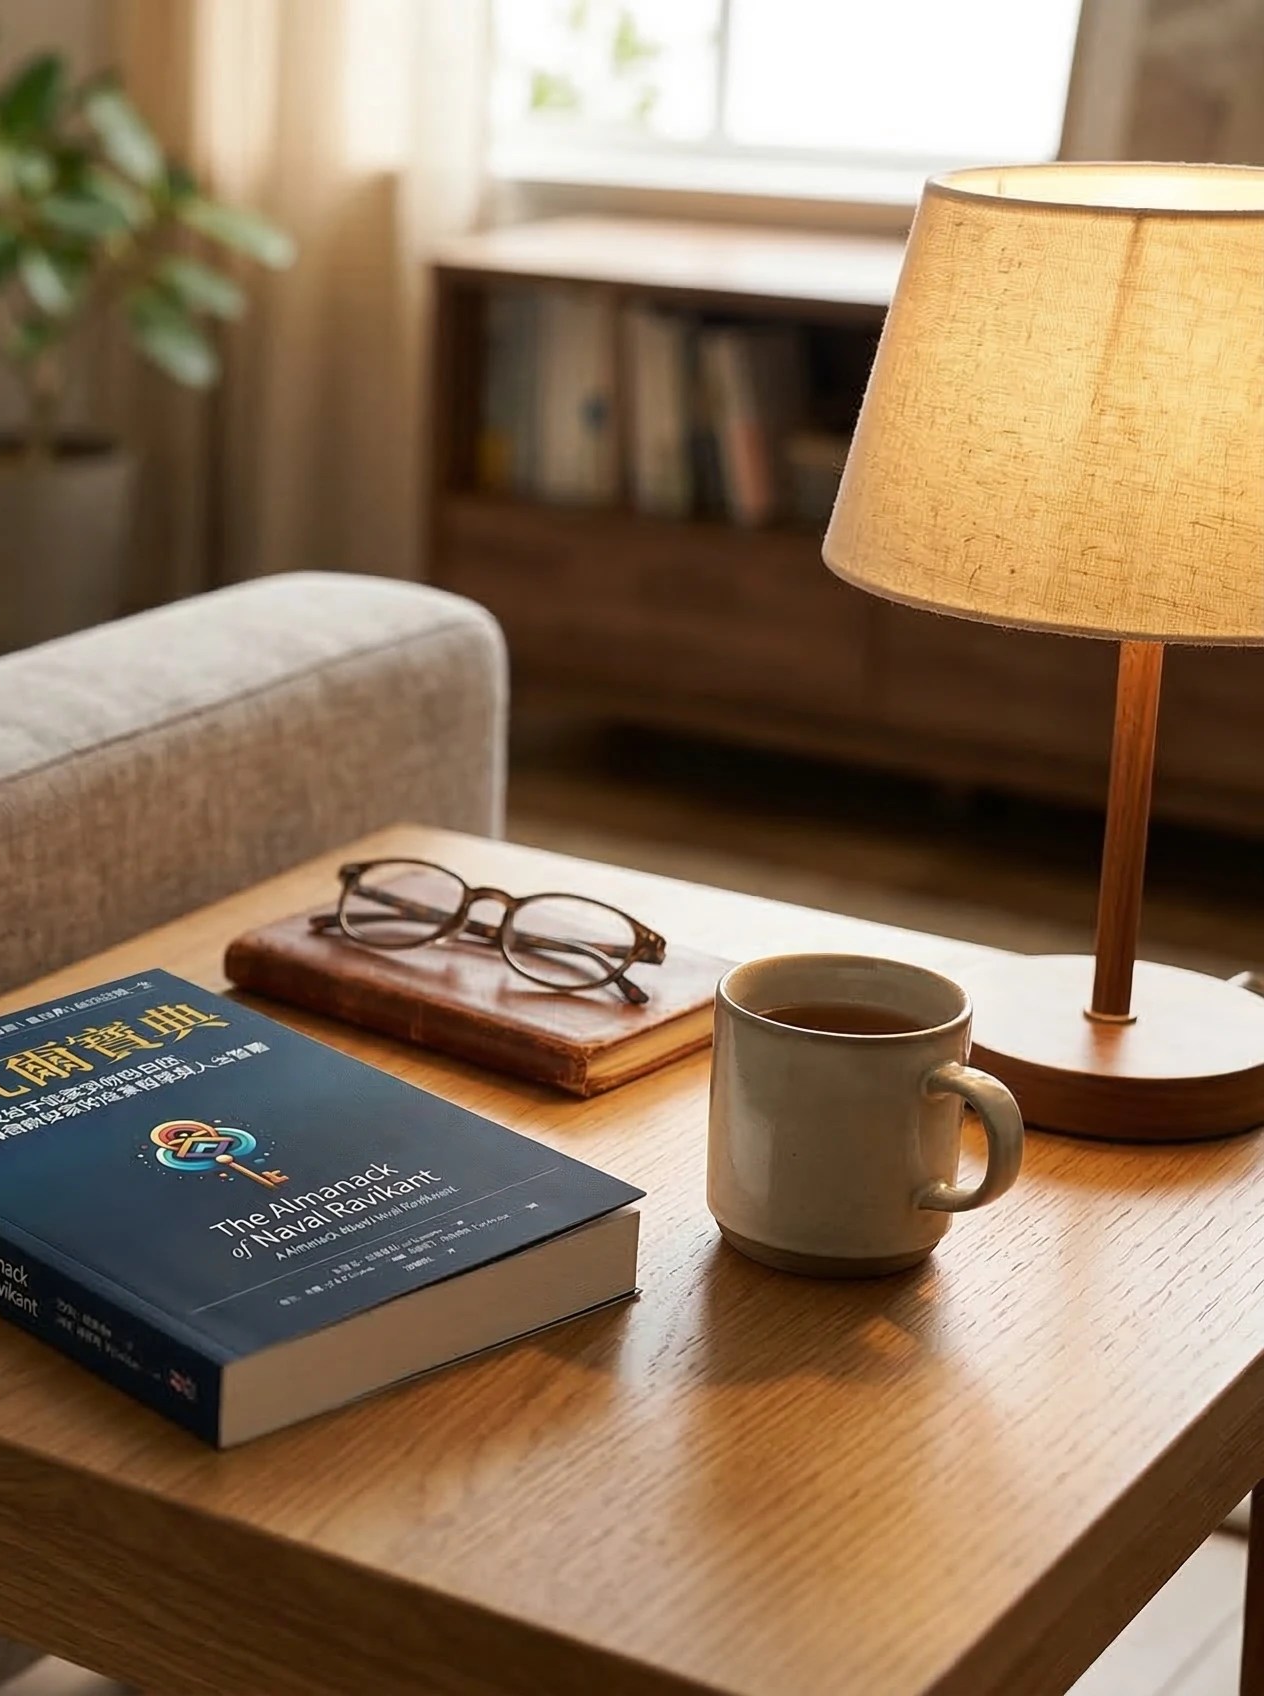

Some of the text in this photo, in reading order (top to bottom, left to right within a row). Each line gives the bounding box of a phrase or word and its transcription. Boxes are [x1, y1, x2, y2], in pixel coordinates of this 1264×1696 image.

[209, 1211, 270, 1238] The
[270, 1163, 399, 1219] Almanack
[232, 1239, 254, 1260] of
[249, 1209, 332, 1248] Naval
[333, 1168, 442, 1220] Ravikant
